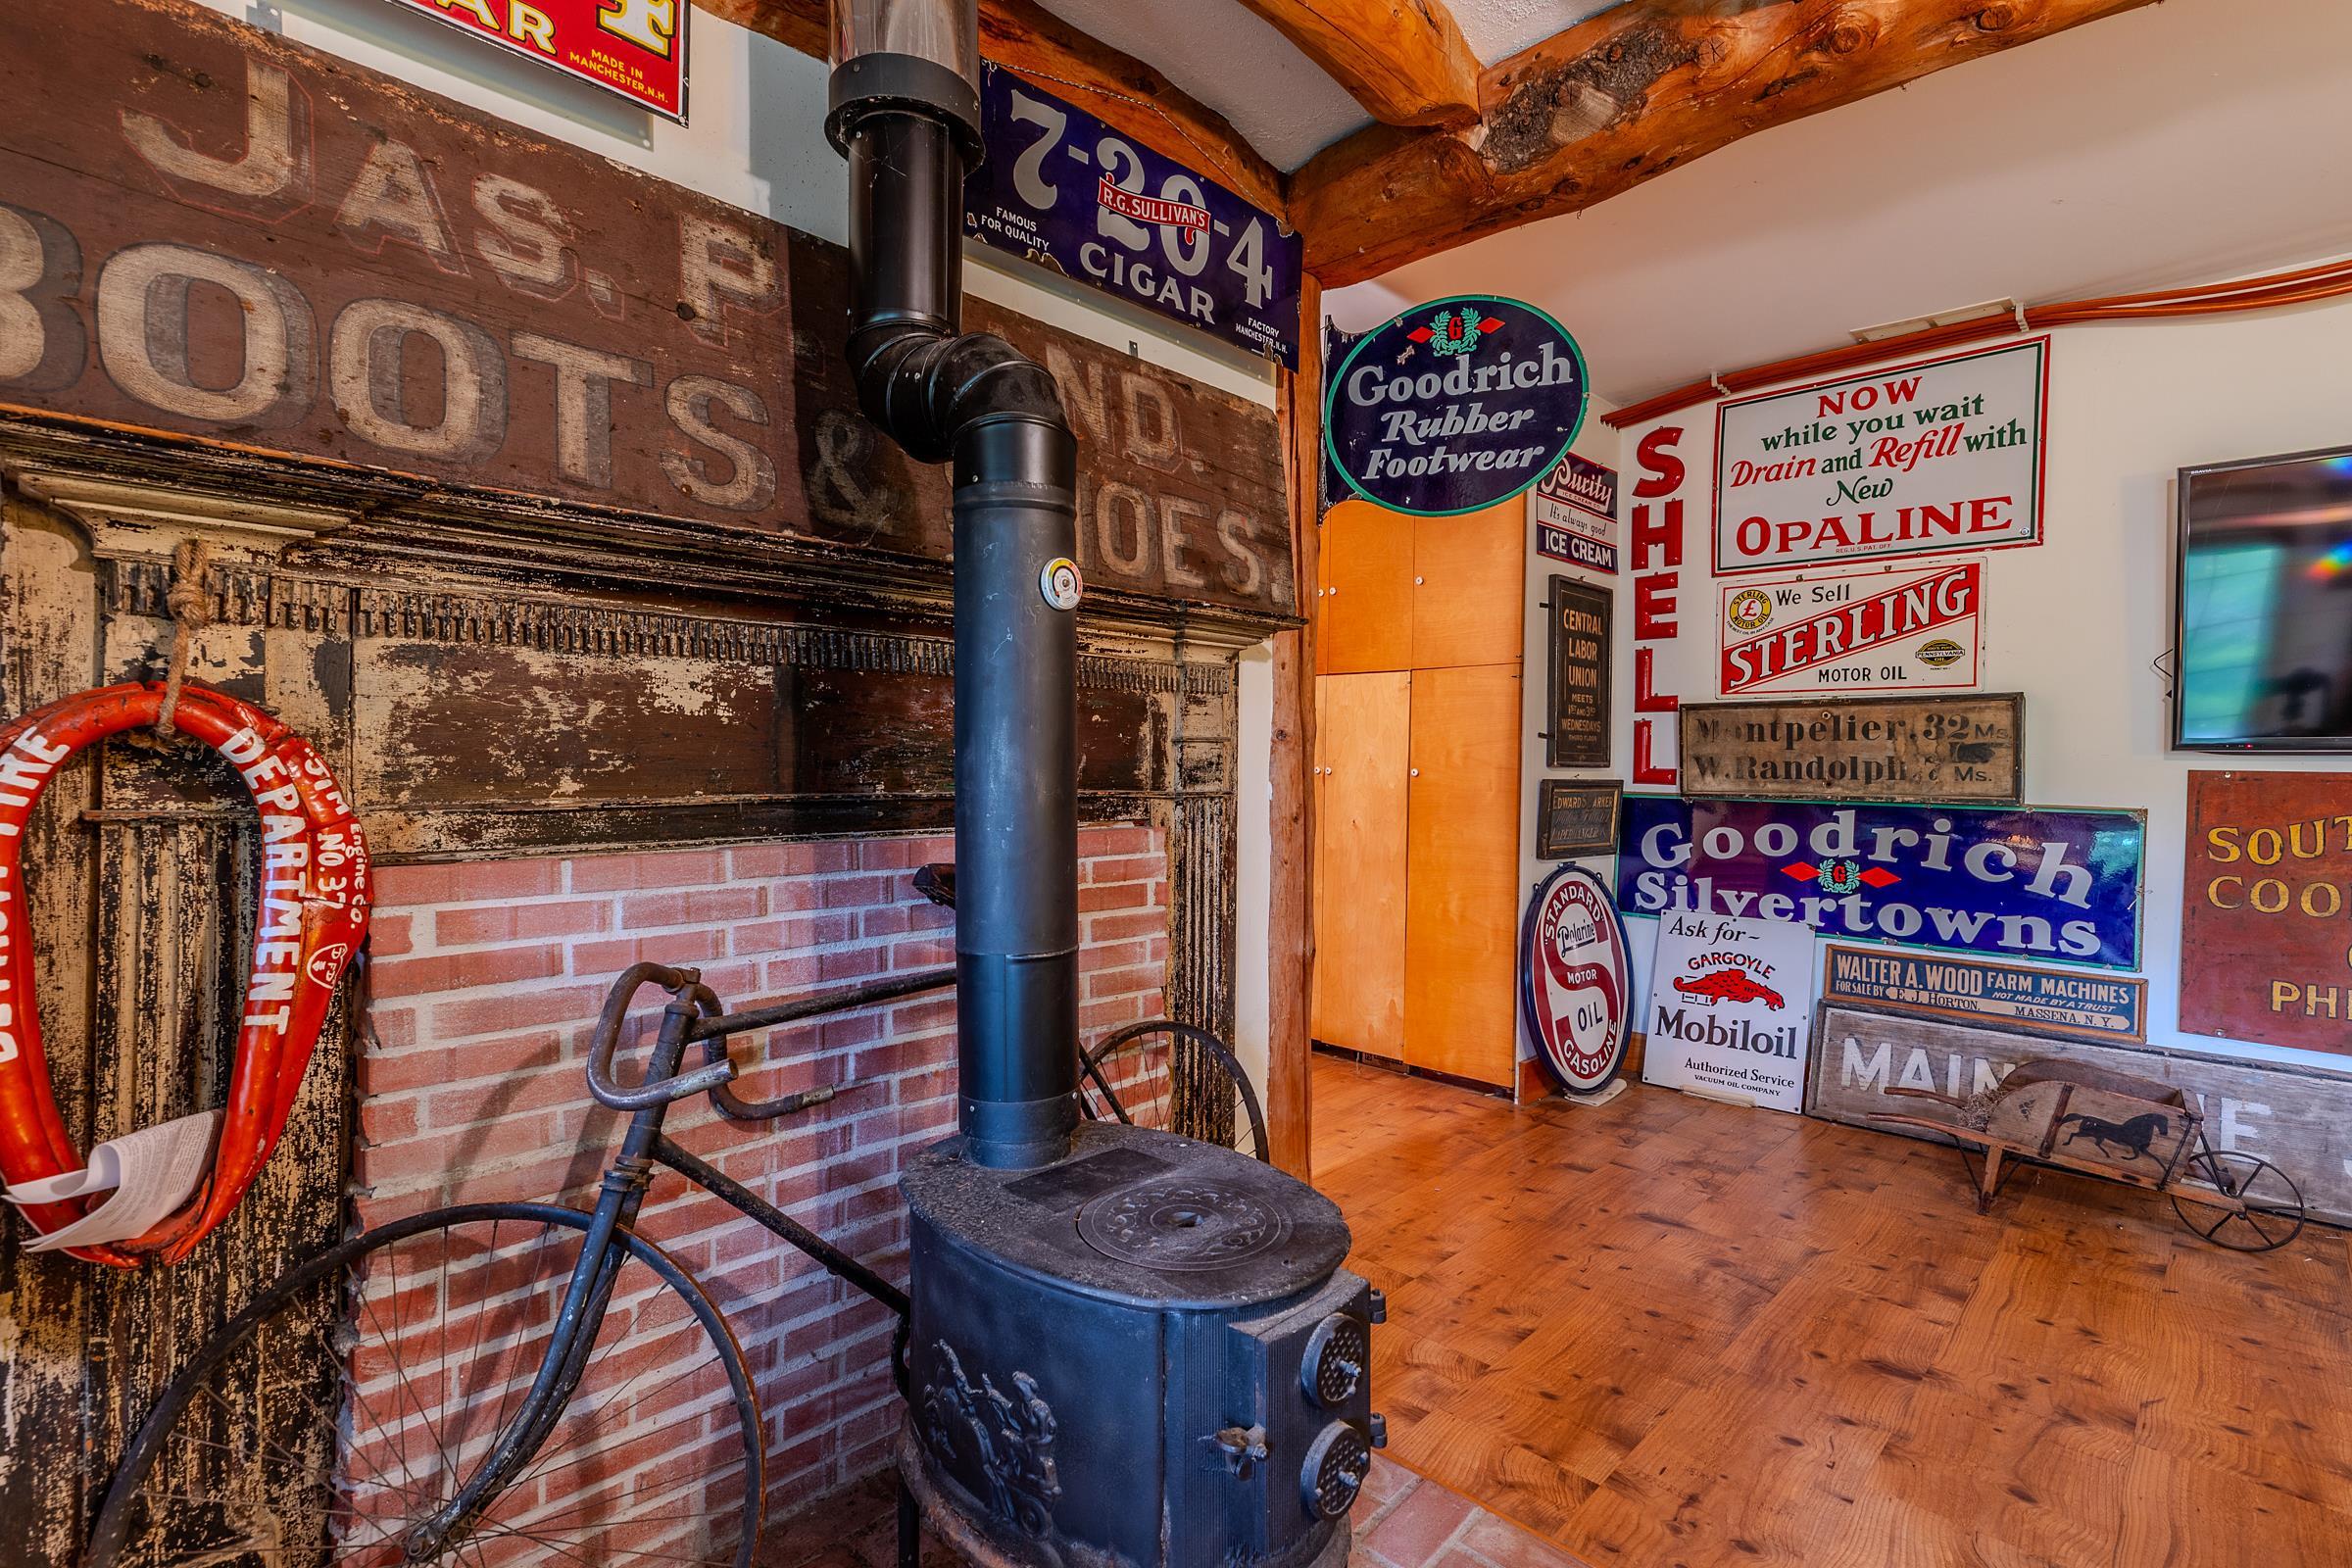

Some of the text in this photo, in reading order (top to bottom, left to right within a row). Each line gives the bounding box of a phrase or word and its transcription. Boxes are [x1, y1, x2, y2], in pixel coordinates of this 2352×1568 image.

[591, 48, 643, 79] MADE IN
[996, 206, 1037, 232] FAMOUS
[1131, 197, 1206, 228] SULLIVAN'S
[981, 214, 1050, 252] FOR QUALITY
[1080, 242, 1215, 325] CIGAR
[1248, 317, 1280, 338] FACTORY
[1348, 341, 1574, 407] Goodrich
[1816, 376, 1923, 418] NOW
[1380, 402, 1535, 445] Rubber
[1761, 393, 1984, 452] while you wait
[1360, 445, 1545, 480] Footwear
[1730, 418, 2027, 488] Drain and Refill with
[805, 410, 904, 535] &
[1541, 457, 1613, 510] Purity
[1826, 475, 1893, 507] New
[1549, 503, 1606, 537] It's always good
[1736, 496, 2013, 557] OPALINE
[1545, 529, 1612, 567] ICE CREAM
[1631, 426, 1685, 785] SHELL
[1733, 591, 1769, 606] STERLING
[1776, 583, 1851, 607] We Sell
[1563, 609, 1602, 636] CENTRAL
[1729, 570, 1972, 689] STERLING
[1734, 612, 1769, 628] MOTOR OIL
[1568, 637, 1597, 662] LABOR
[1568, 664, 1596, 688] UNION
[1818, 665, 1907, 683] MOTOR OIL
[1571, 693, 1593, 704] MEETS
[1561, 718, 1601, 732] WEDNESDAYS
[1924, 713, 1970, 740] 32
[1691, 754, 1731, 780] W.
[1954, 765, 1992, 782] Ms.
[1590, 795, 1613, 808] ARKER
[346, 821, 366, 892] Engine
[1641, 809, 2093, 910] Goodrich
[219, 727, 309, 1036] DEPARTMENT
[316, 875, 348, 910] 37
[2207, 875, 2352, 918] COO
[349, 891, 367, 930] Co.
[1635, 870, 2103, 957] Silvertowns
[1668, 915, 1746, 946] Ask for
[1566, 968, 1597, 985] MOTOR
[1688, 951, 1776, 980] GARGOYLE
[1837, 954, 2130, 1004] WALTER A. WOOD FARM MACHINES
[1836, 981, 1884, 997] FOR SALE BY
[1991, 991, 2014, 1000] NOT
[2014, 994, 2047, 1005] MADE
[2077, 1002, 2117, 1013] TRUST
[2272, 980, 2352, 1021] PH
[1577, 1001, 1603, 1032] OIL
[1654, 1005, 1797, 1060] Mobiloil
[1563, 1018, 1617, 1075] GASOLINE
[1684, 1056, 1794, 1089] Authorized Service
[1694, 1074, 1726, 1086] VACUUM
[1740, 1083, 1781, 1097] COMPANY
[1841, 1034, 2017, 1103] MAIN
